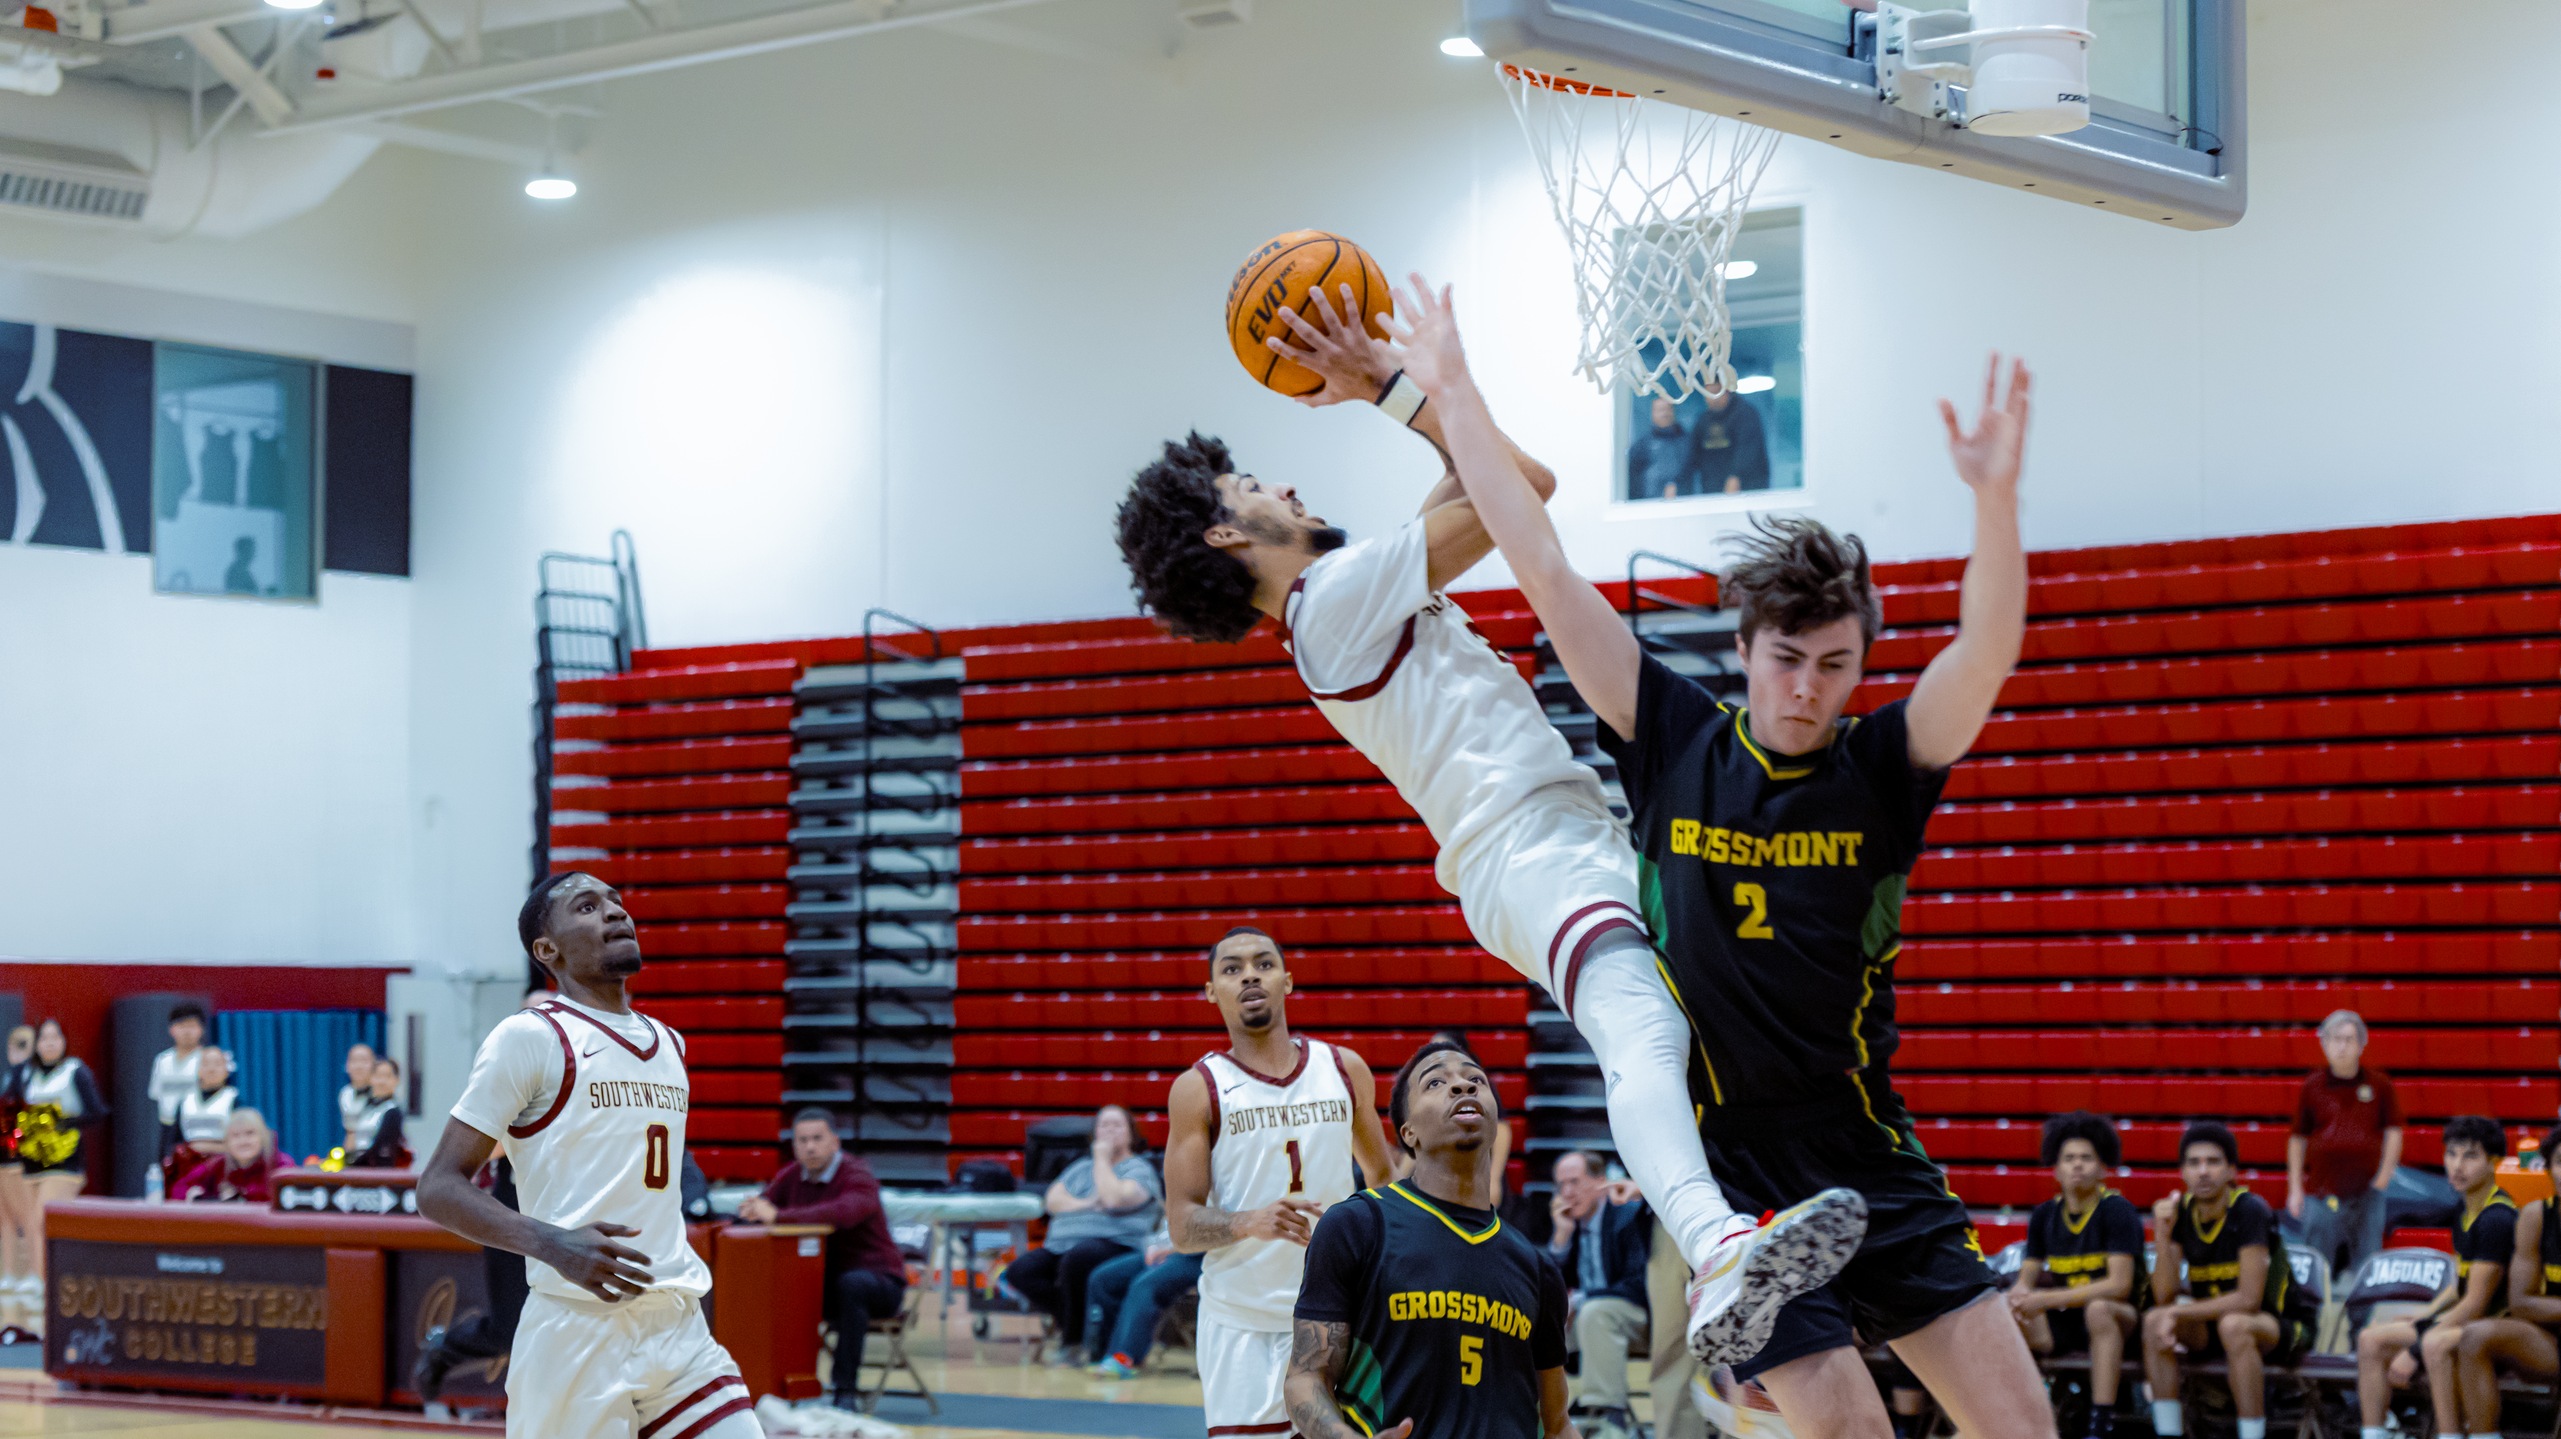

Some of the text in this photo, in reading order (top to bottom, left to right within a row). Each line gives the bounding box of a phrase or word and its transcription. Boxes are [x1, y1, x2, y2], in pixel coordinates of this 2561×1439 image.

[1247, 277, 1288, 345] EVO
[1733, 881, 1774, 940] 2
[589, 1081, 688, 1114] SOUTHWESTER
[1228, 1100, 1348, 1136] SOUTHWESTERN
[643, 1122, 669, 1192] 0
[1284, 1139, 1304, 1194] 1
[2364, 1257, 2447, 1291] JAGUARS
[58, 1275, 326, 1331] SOUTHWESTERN
[124, 1328, 257, 1367] COLLEGE
[1459, 1334, 1484, 1386] 5
